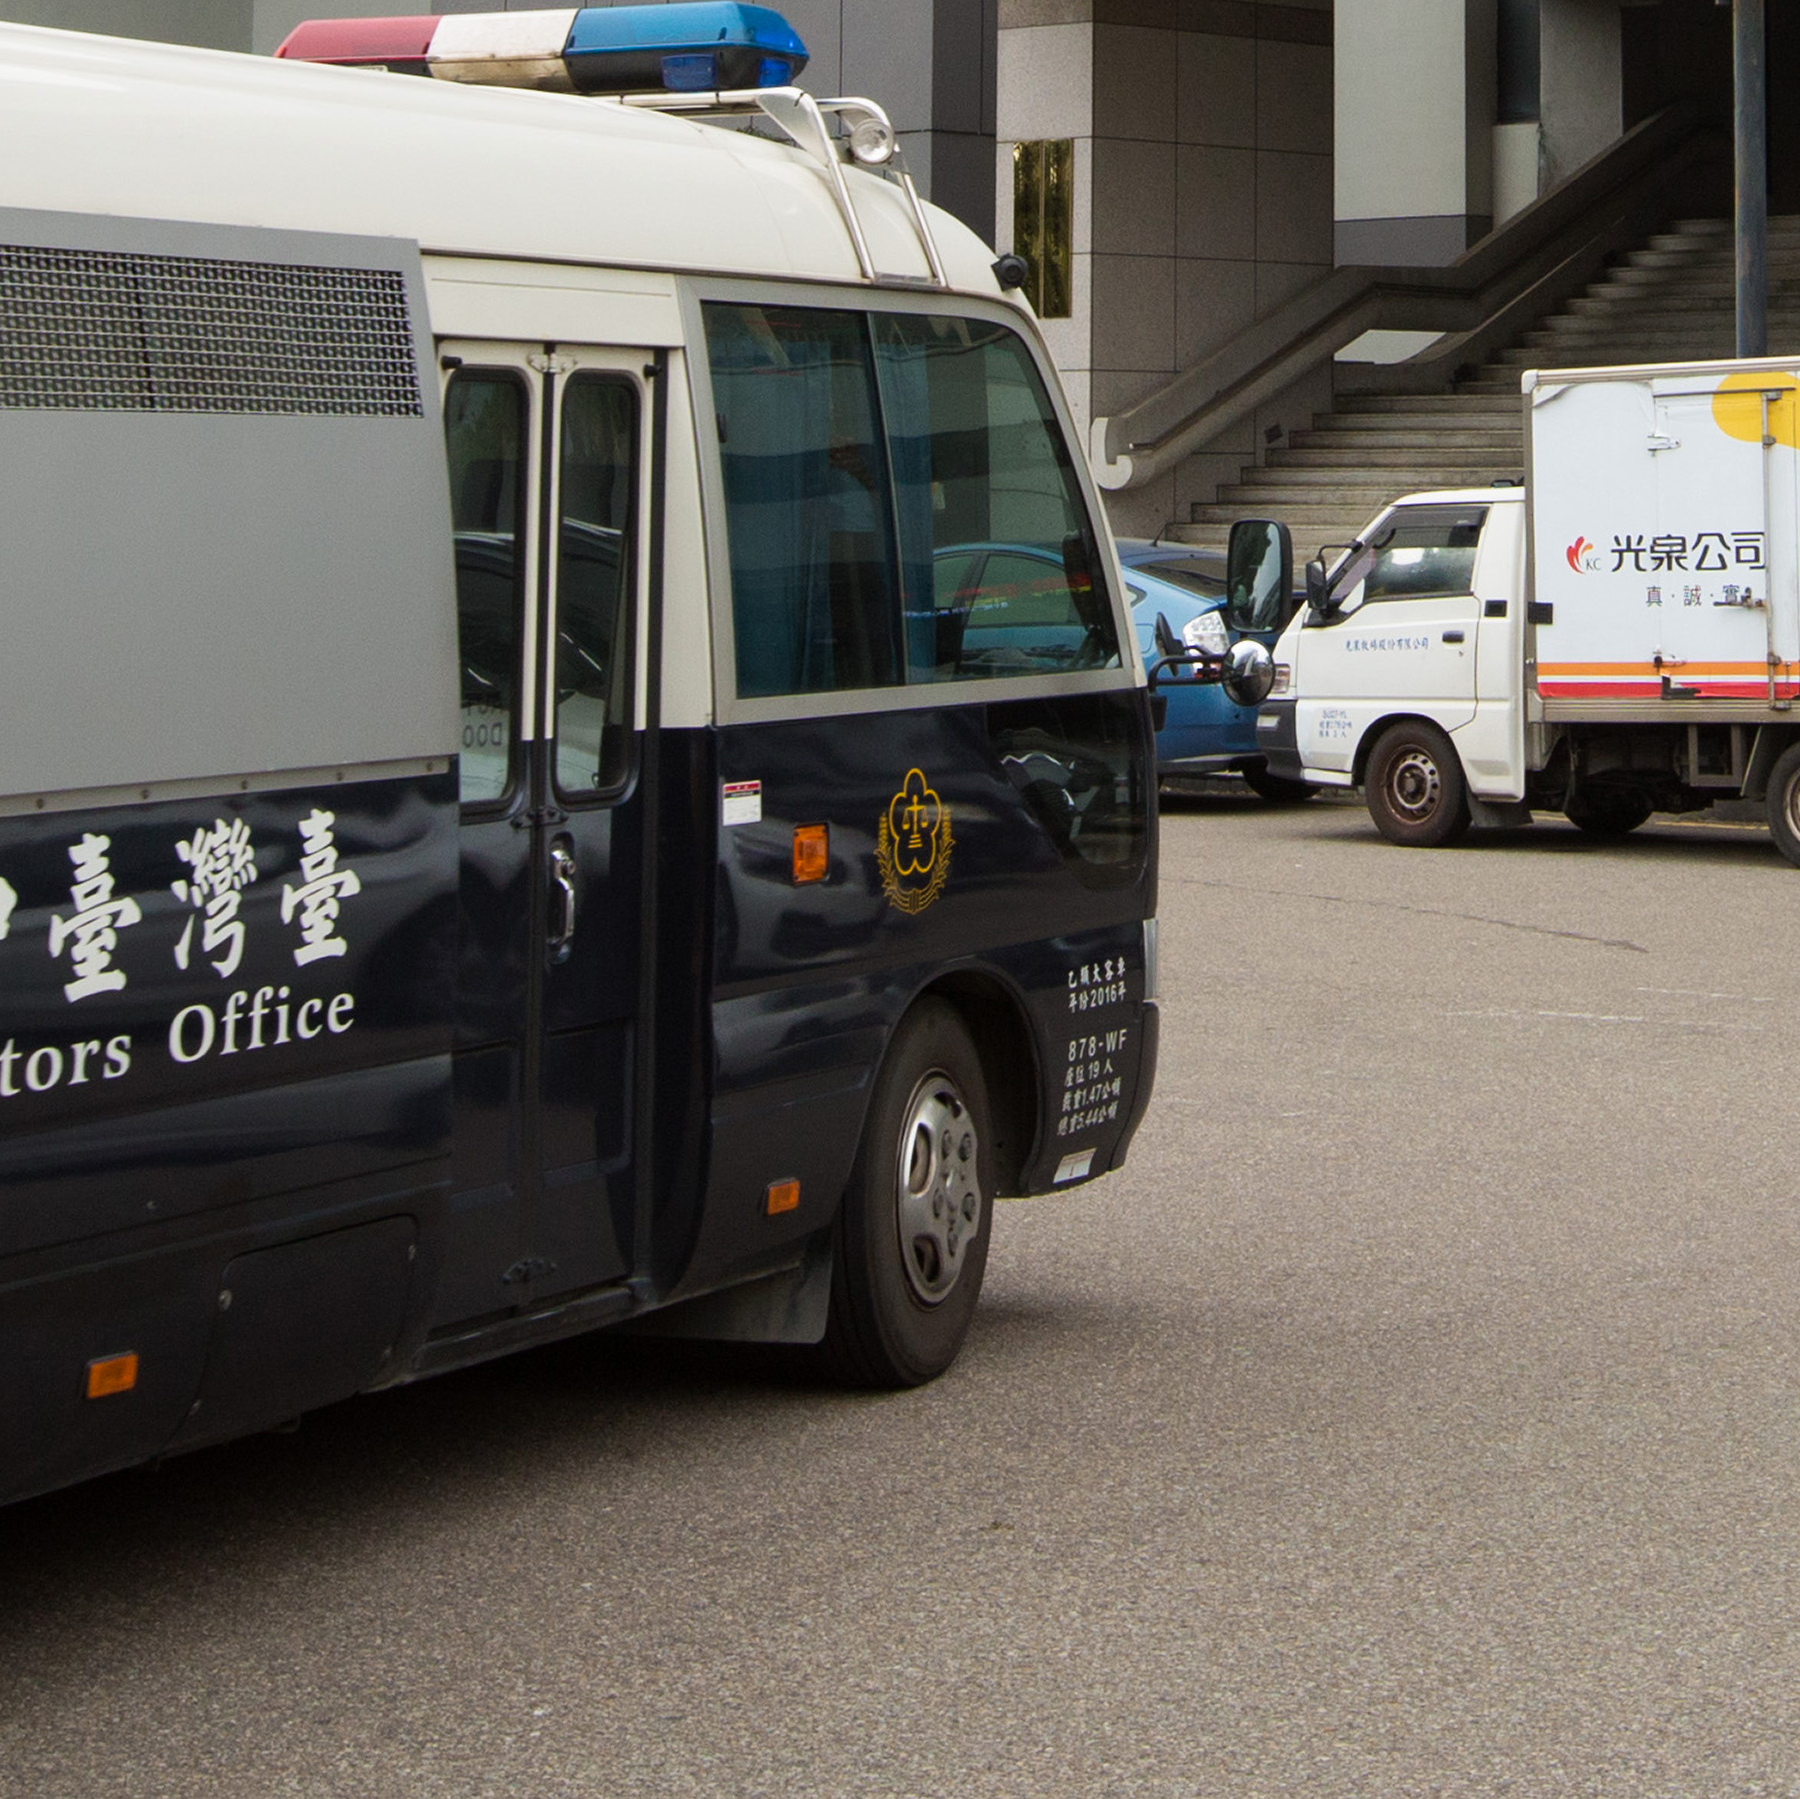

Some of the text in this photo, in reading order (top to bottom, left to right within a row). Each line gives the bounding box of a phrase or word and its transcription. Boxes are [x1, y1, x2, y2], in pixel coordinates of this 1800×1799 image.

[1585, 556, 1602, 571] KC
[1610, 530, 1766, 573] 光泉公司
[168, 985, 355, 1064] Office
[1067, 1028, 1127, 1062] 878-WF
